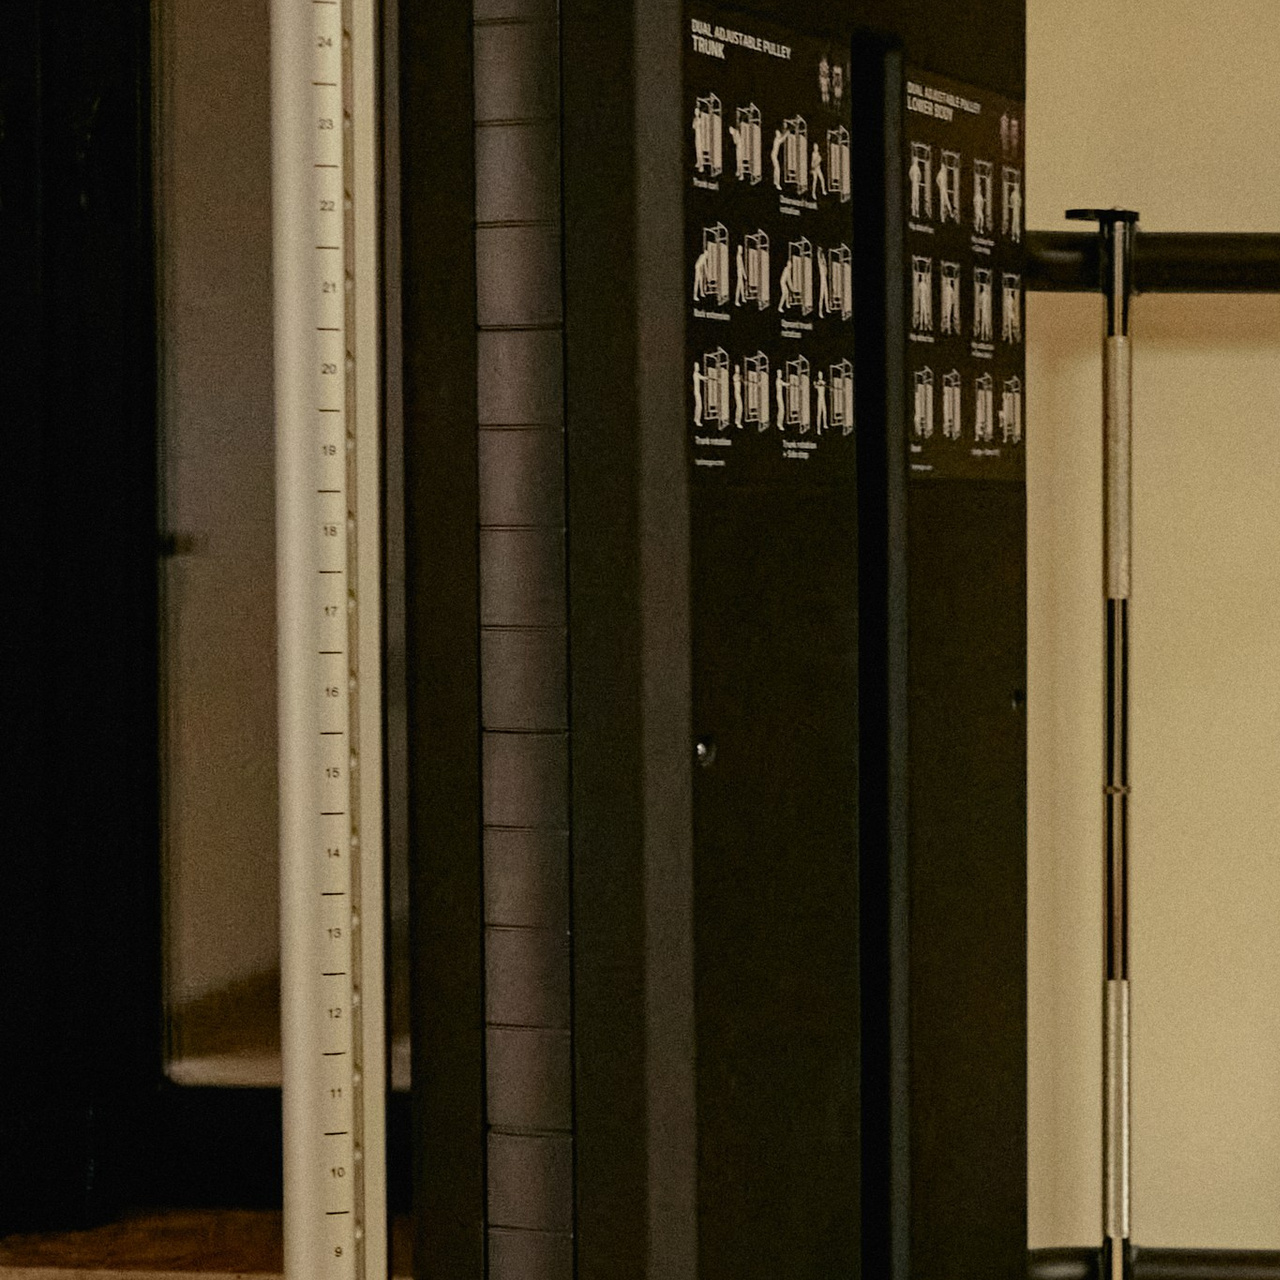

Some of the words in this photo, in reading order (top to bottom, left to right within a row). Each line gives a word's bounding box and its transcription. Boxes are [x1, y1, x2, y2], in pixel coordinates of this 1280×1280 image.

[318, 36, 333, 48] 24
[713, 26, 762, 52] ADJUSTABLE
[692, 34, 725, 60] TRUNK
[318, 118, 334, 130] 23
[320, 200, 335, 212] 22
[322, 281, 336, 294] 21
[322, 363, 337, 375] 20
[322, 445, 336, 456] 19
[323, 526, 337, 537] 18
[324, 606, 338, 616] 17
[325, 687, 339, 697] 16
[326, 767, 340, 778] 15
[327, 848, 340, 858] 14
[327, 928, 342, 938] 13
[328, 1007, 342, 1019] 12
[330, 1088, 342, 1098] 11
[331, 1167, 345, 1178] 10
[335, 1246, 343, 1258] 9
